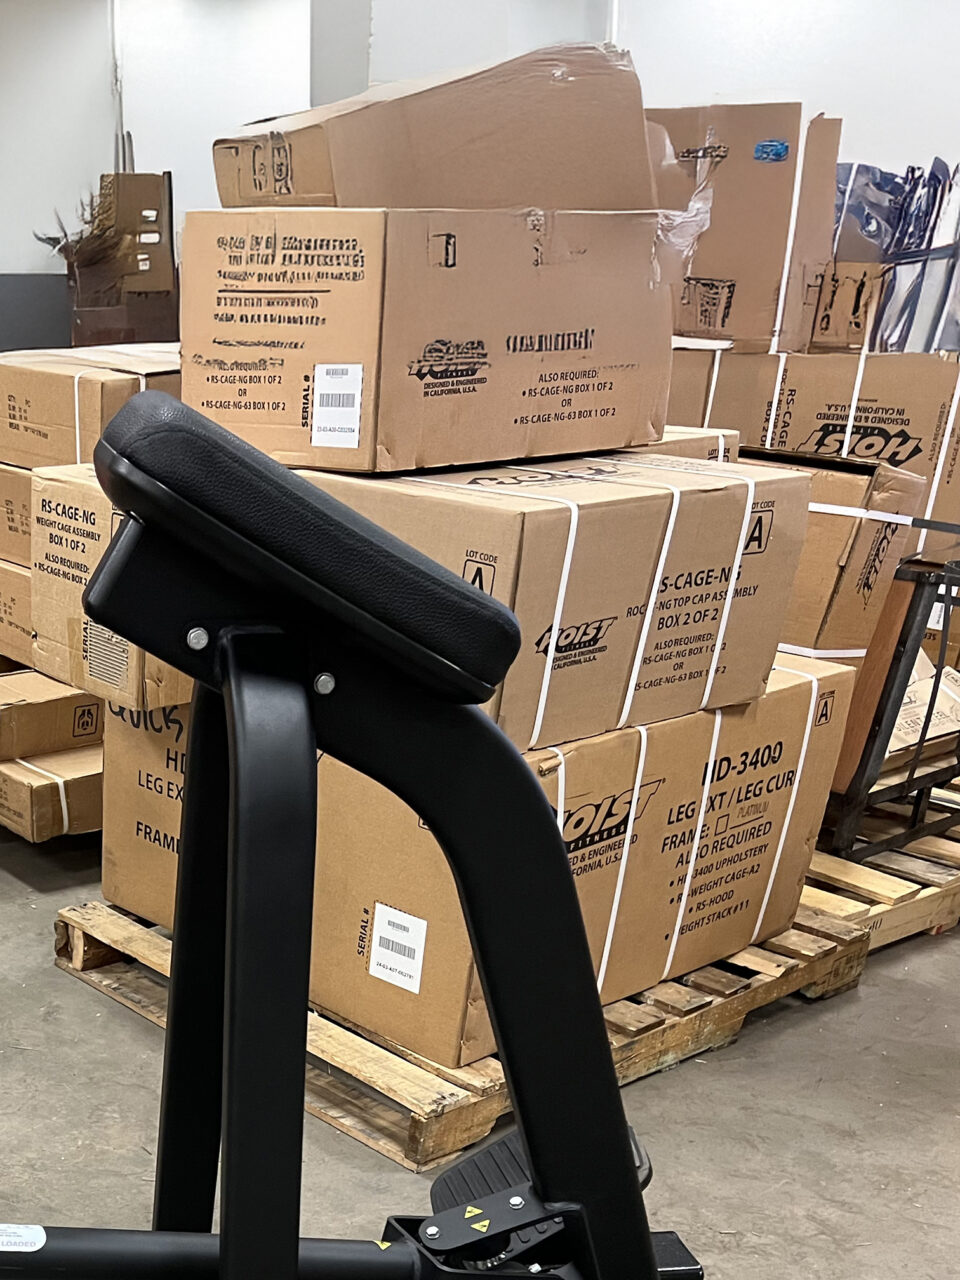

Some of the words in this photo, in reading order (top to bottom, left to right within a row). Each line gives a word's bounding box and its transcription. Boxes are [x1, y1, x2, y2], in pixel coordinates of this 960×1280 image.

[211, 375, 247, 384] RS-CAGE-NG
[249, 375, 261, 384] BOX
[267, 375, 276, 384] OF
[277, 376, 282, 384] 2
[424, 381, 450, 390] DESIGNED
[455, 377, 488, 386] ENGINEERED
[538, 373, 558, 383] ALSO
[559, 369, 599, 381] REQUIRED:
[238, 388, 247, 397] OR
[528, 385, 573, 398] RS-CAGE-NG
[575, 383, 590, 393] BOX
[596, 382, 607, 392] OF
[608, 382, 613, 391] 2
[206, 400, 252, 410] RS-CAGE-NG-63
[253, 402, 265, 410] BOX
[271, 402, 280, 411] OF
[281, 402, 286, 411] 2
[302, 384, 310, 428] SERIAL
[561, 398, 572, 407] OR
[764, 401, 773, 424] BOX
[848, 404, 894, 416] CALIFORN,
[897, 408, 905, 416] IN
[520, 411, 576, 425] RS-CAGE-NG-63
[578, 409, 592, 419] BOX
[594, 409, 598, 418] 1
[599, 408, 610, 417] OF
[611, 408, 616, 416] 2
[816, 413, 862, 423] ENINEERED
[863, 415, 869, 423] &
[871, 416, 910, 426] DESIGNED
[796, 430, 922, 467] HOIST
[41, 499, 96, 526] RS-CAGE-NG
[760, 501, 776, 509] CODE
[36, 516, 57, 530] WEIGHT
[57, 520, 72, 534] CAGE
[72, 524, 101, 542] ASSEMBLY
[744, 515, 762, 551] A
[49, 533, 63, 547] BOX
[64, 538, 69, 548] 1
[70, 538, 80, 551] OF
[80, 542, 86, 554] 2
[45, 552, 59, 565] ALSO
[59, 555, 90, 574] REQUIRED:
[466, 549, 478, 559] LOT
[479, 552, 498, 563] CODE
[38, 562, 71, 581] RS-CAGE-NG
[71, 572, 83, 585] BOX
[83, 576, 88, 587] 2
[658, 565, 742, 594] S-CAGE-N
[626, 600, 672, 618] ROC-NG
[673, 596, 690, 609] TOP
[691, 593, 711, 605] CAP
[711, 585, 759, 602] ASSMBLY
[657, 612, 681, 631] BOX
[682, 612, 690, 626] 2
[693, 608, 709, 624] OF
[711, 608, 719, 621] 2
[535, 616, 618, 656] HOIST
[654, 639, 673, 651] ALSO
[673, 632, 714, 647] REQUIRED:
[553, 653, 573, 663] SIGNED
[642, 649, 687, 665] RS-CAGE-NG
[688, 646, 703, 657] BOX
[705, 645, 709, 653] 1
[721, 642, 727, 651] 2
[673, 662, 684, 671] OR
[688, 670, 704, 681] BOX
[721, 666, 727, 674] 2
[817, 700, 828, 723] A
[138, 770, 163, 795] LEG
[167, 781, 184, 801] EX
[667, 800, 696, 825] LEG
[699, 791, 727, 814] XT
[727, 788, 735, 808] /
[736, 780, 764, 804] LEG
[766, 769, 798, 794] CUR
[552, 778, 662, 842] OIST
[570, 824, 625, 851] FITNESS
[580, 852, 587, 863] &
[588, 833, 638, 860] ENGINEED
[711, 821, 772, 855] REQUIRED
[571, 860, 604, 877] FORNIA,
[676, 863, 714, 886] H-3400
[715, 843, 769, 870] UPHOLSTERY
[677, 876, 726, 903] R-WEIGHT
[724, 864, 760, 884] CAGE-A2
[695, 889, 734, 912] RS-HOOD
[679, 916, 705, 935] EIGHT
[705, 906, 732, 925] STACK
[357, 918, 369, 957] SERIAL
